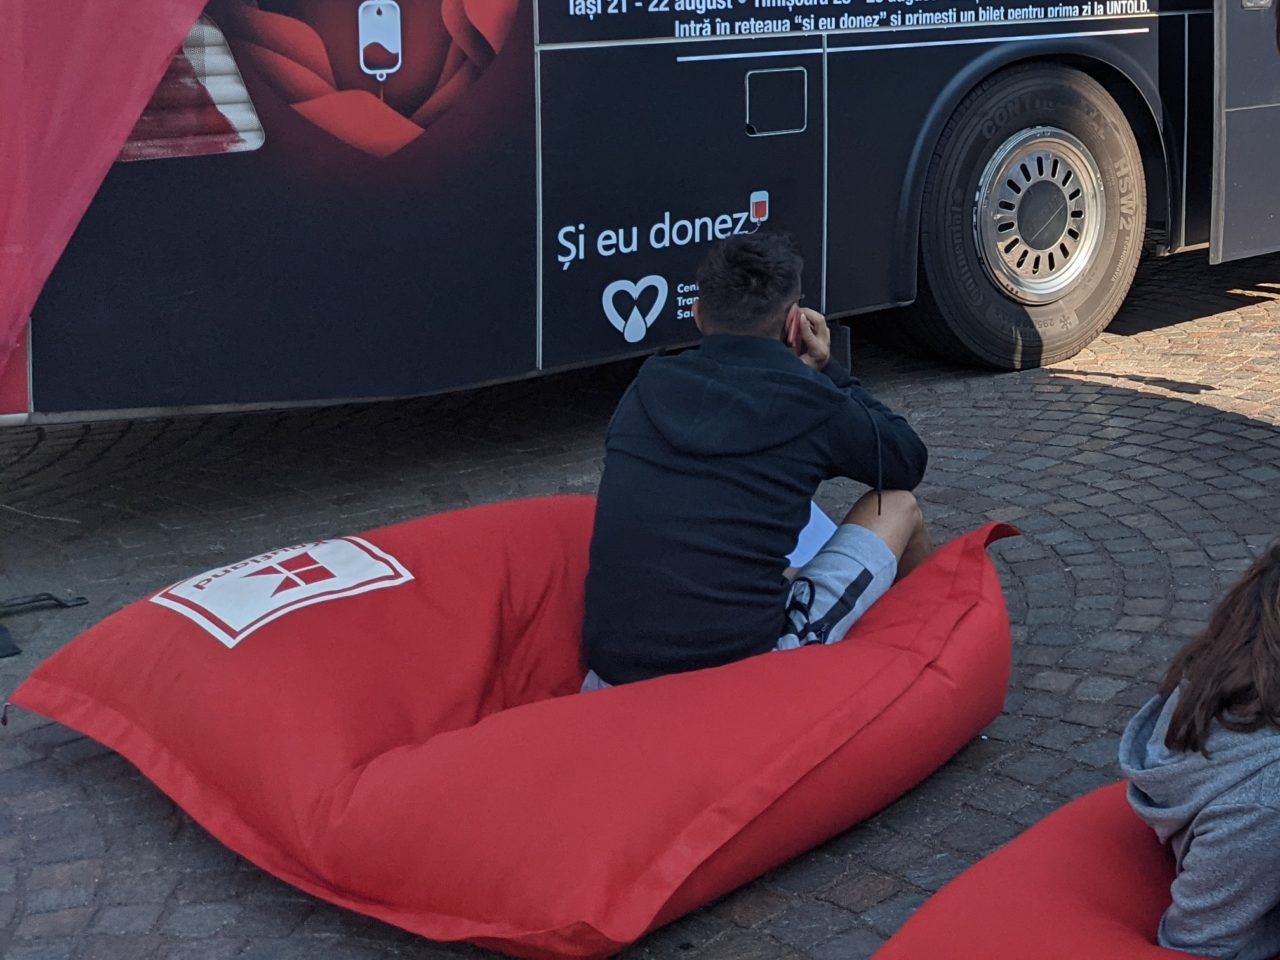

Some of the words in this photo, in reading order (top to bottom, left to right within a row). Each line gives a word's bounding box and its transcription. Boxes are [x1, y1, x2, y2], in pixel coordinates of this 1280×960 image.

[675, 19, 711, 37] Intră
[716, 18, 730, 35] în
[819, 17, 835, 29] eu
[960, 11, 975, 22] un
[979, 6, 1004, 21] bilet
[1008, 5, 1044, 20] pentru
[1048, 3, 1079, 17] prima
[1082, 2, 1091, 15] zi
[1094, 2, 1104, 15] la
[1107, 0, 1150, 14] UNTOLD.
[557, 223, 585, 270] Și
[597, 226, 638, 256] eu
[650, 211, 749, 249] donez
